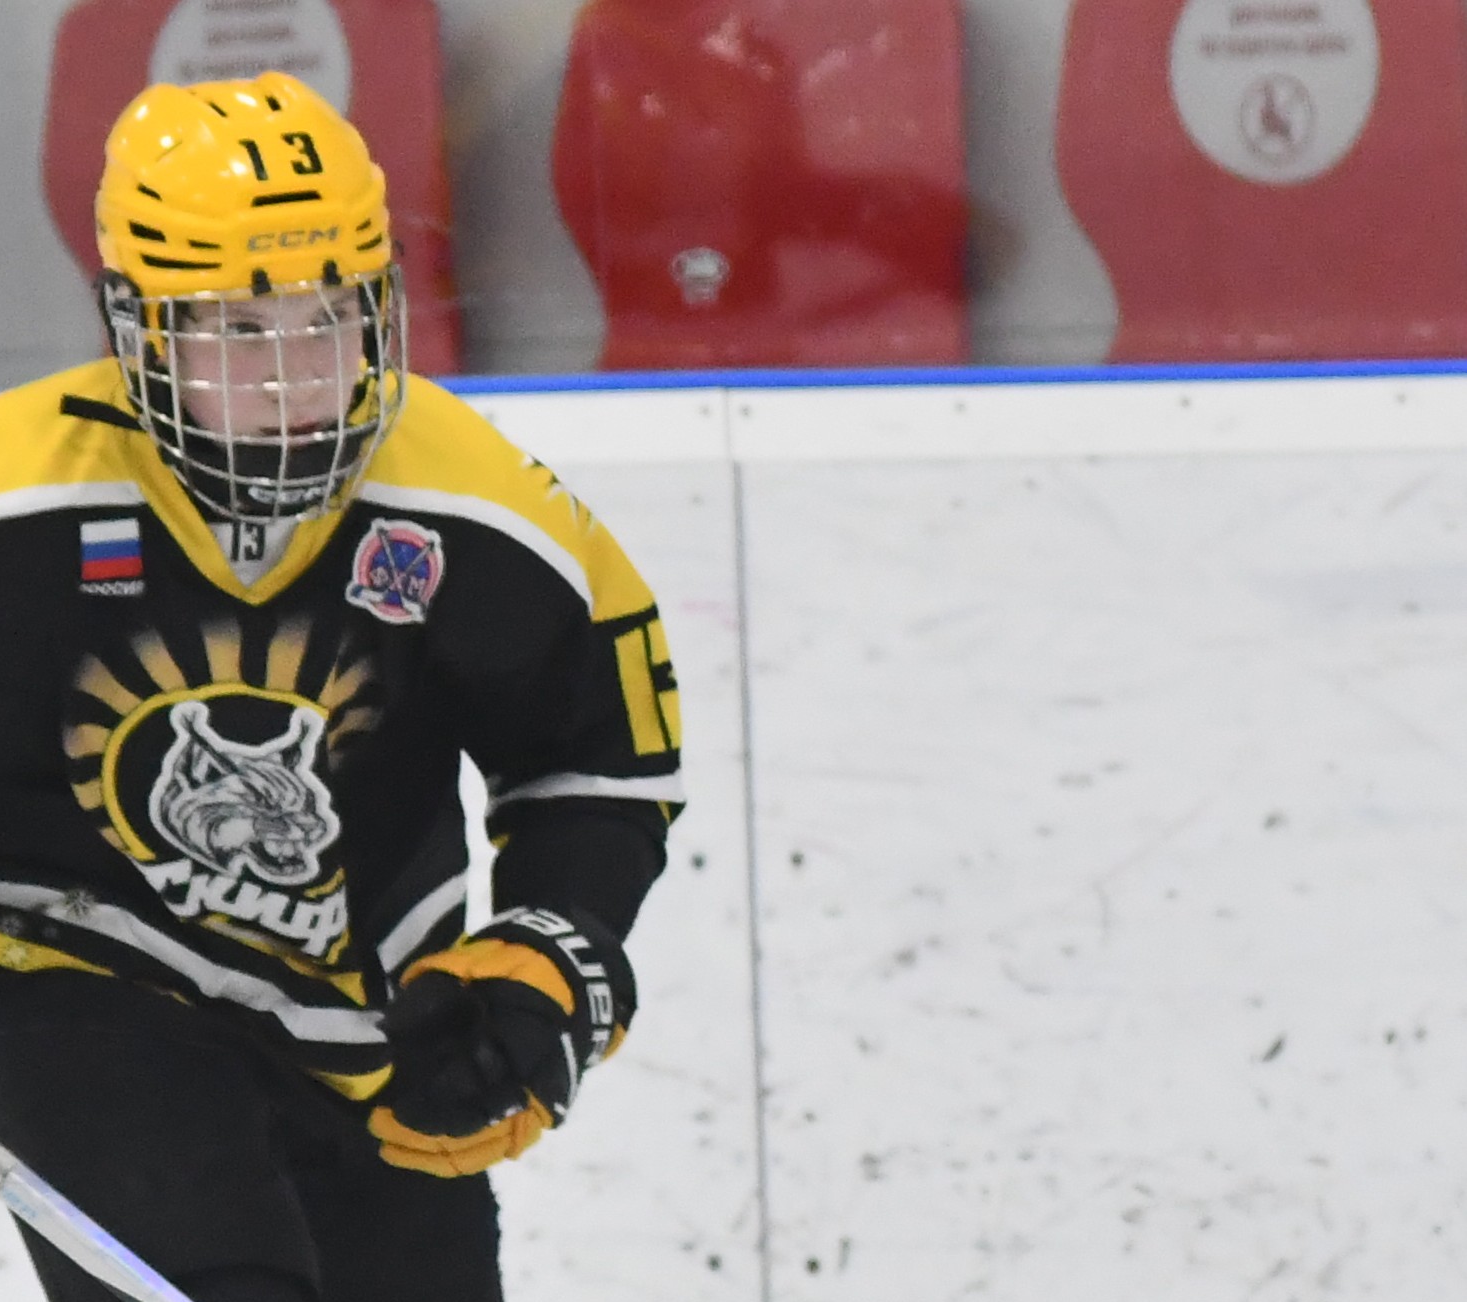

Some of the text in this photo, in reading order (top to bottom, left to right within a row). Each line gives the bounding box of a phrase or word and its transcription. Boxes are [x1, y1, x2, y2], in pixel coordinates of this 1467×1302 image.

[238, 131, 324, 182] 13
[247, 226, 340, 252] CCM
[230, 519, 267, 562] 13
